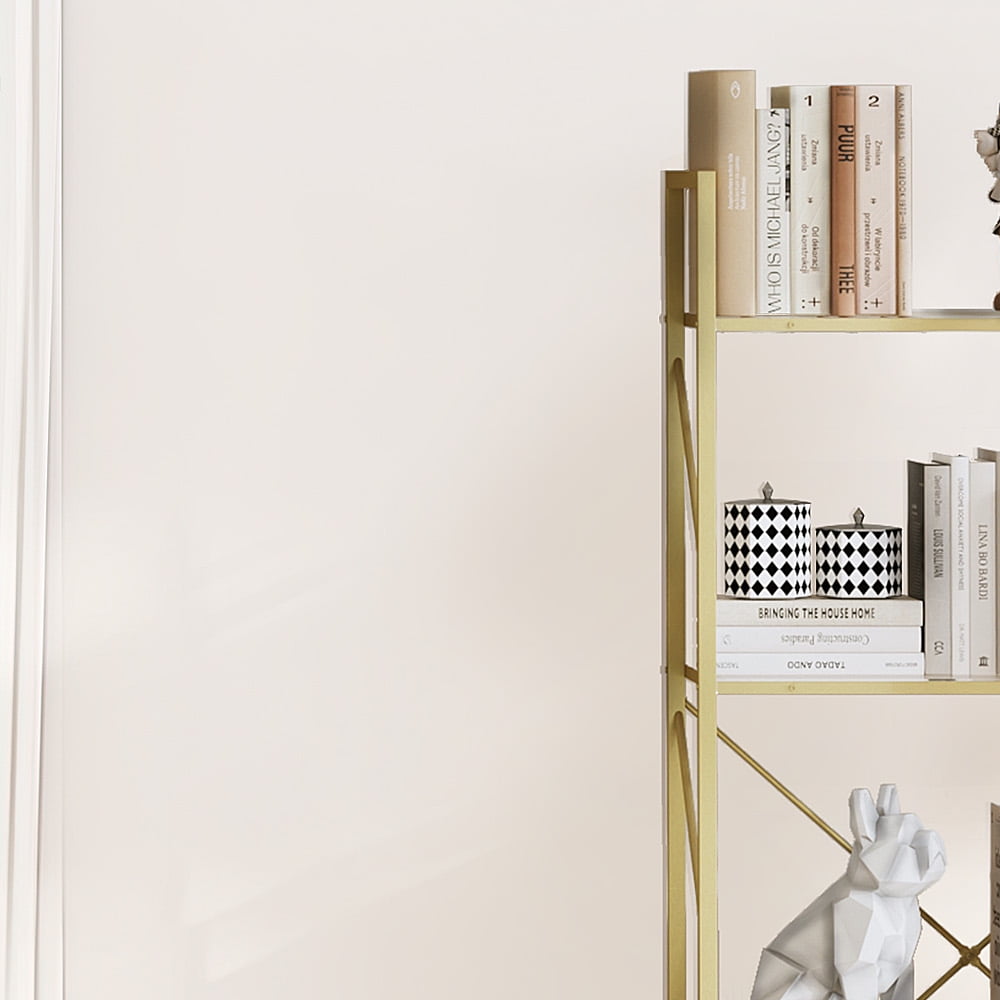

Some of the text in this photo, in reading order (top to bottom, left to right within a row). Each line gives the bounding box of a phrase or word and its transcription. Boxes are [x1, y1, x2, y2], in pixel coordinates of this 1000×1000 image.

[804, 95, 812, 106] 1
[868, 95, 879, 107] 2
[811, 140, 819, 165] Zmiana
[875, 140, 883, 166] Zmiana
[838, 124, 854, 295] PUUR THEE
[767, 123, 781, 314] WHO IS MICHAEL JANG?
[811, 226, 819, 237] Od
[933, 528, 944, 547] LOUIS
[978, 524, 988, 600] LINA BO BARDI
[759, 608, 876, 619] BRINGING THE HOUSE HOME
[934, 641, 944, 656] CCA
[787, 661, 845, 669] TADAO ANDO
